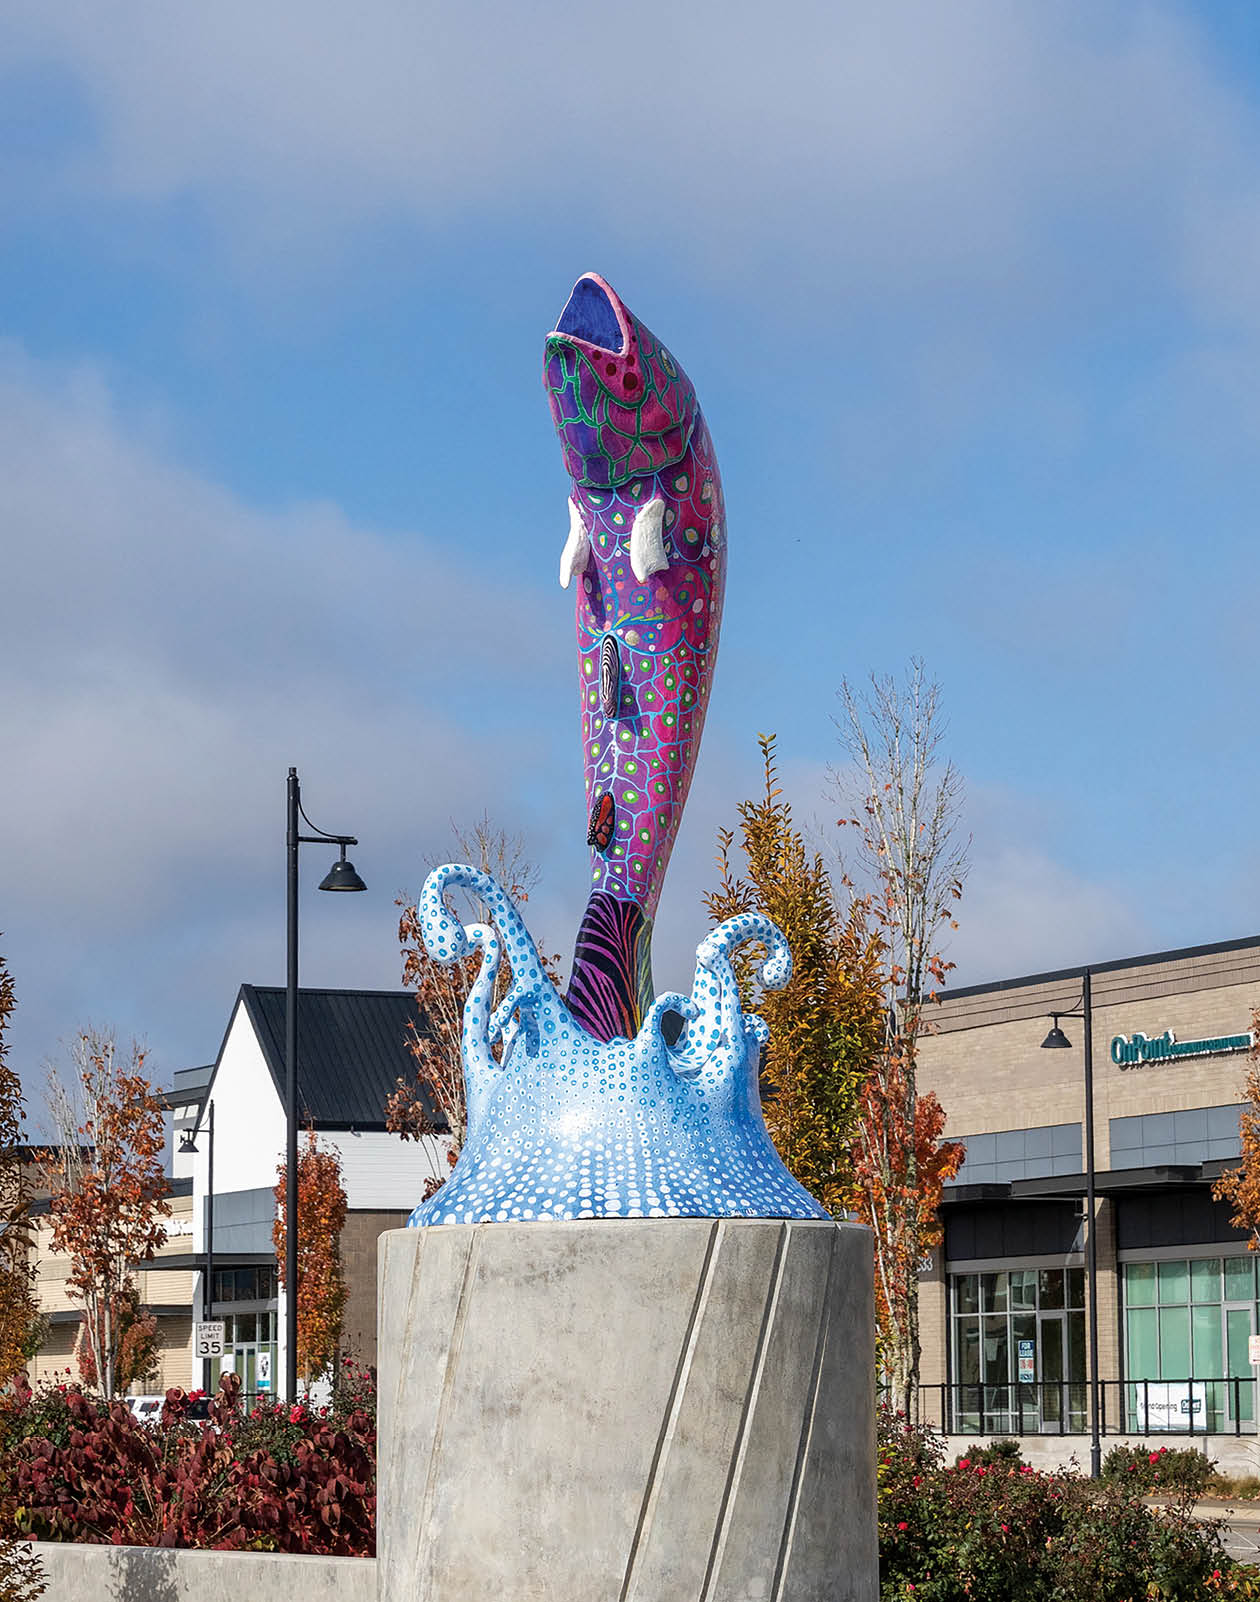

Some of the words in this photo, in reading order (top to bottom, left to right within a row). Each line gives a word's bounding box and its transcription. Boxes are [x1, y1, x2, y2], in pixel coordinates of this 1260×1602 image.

[1111, 1030, 1174, 1064] OnPoint
[198, 1324, 223, 1332] SPEED
[200, 1332, 220, 1340] LIMIT
[199, 1341, 221, 1354] 35
